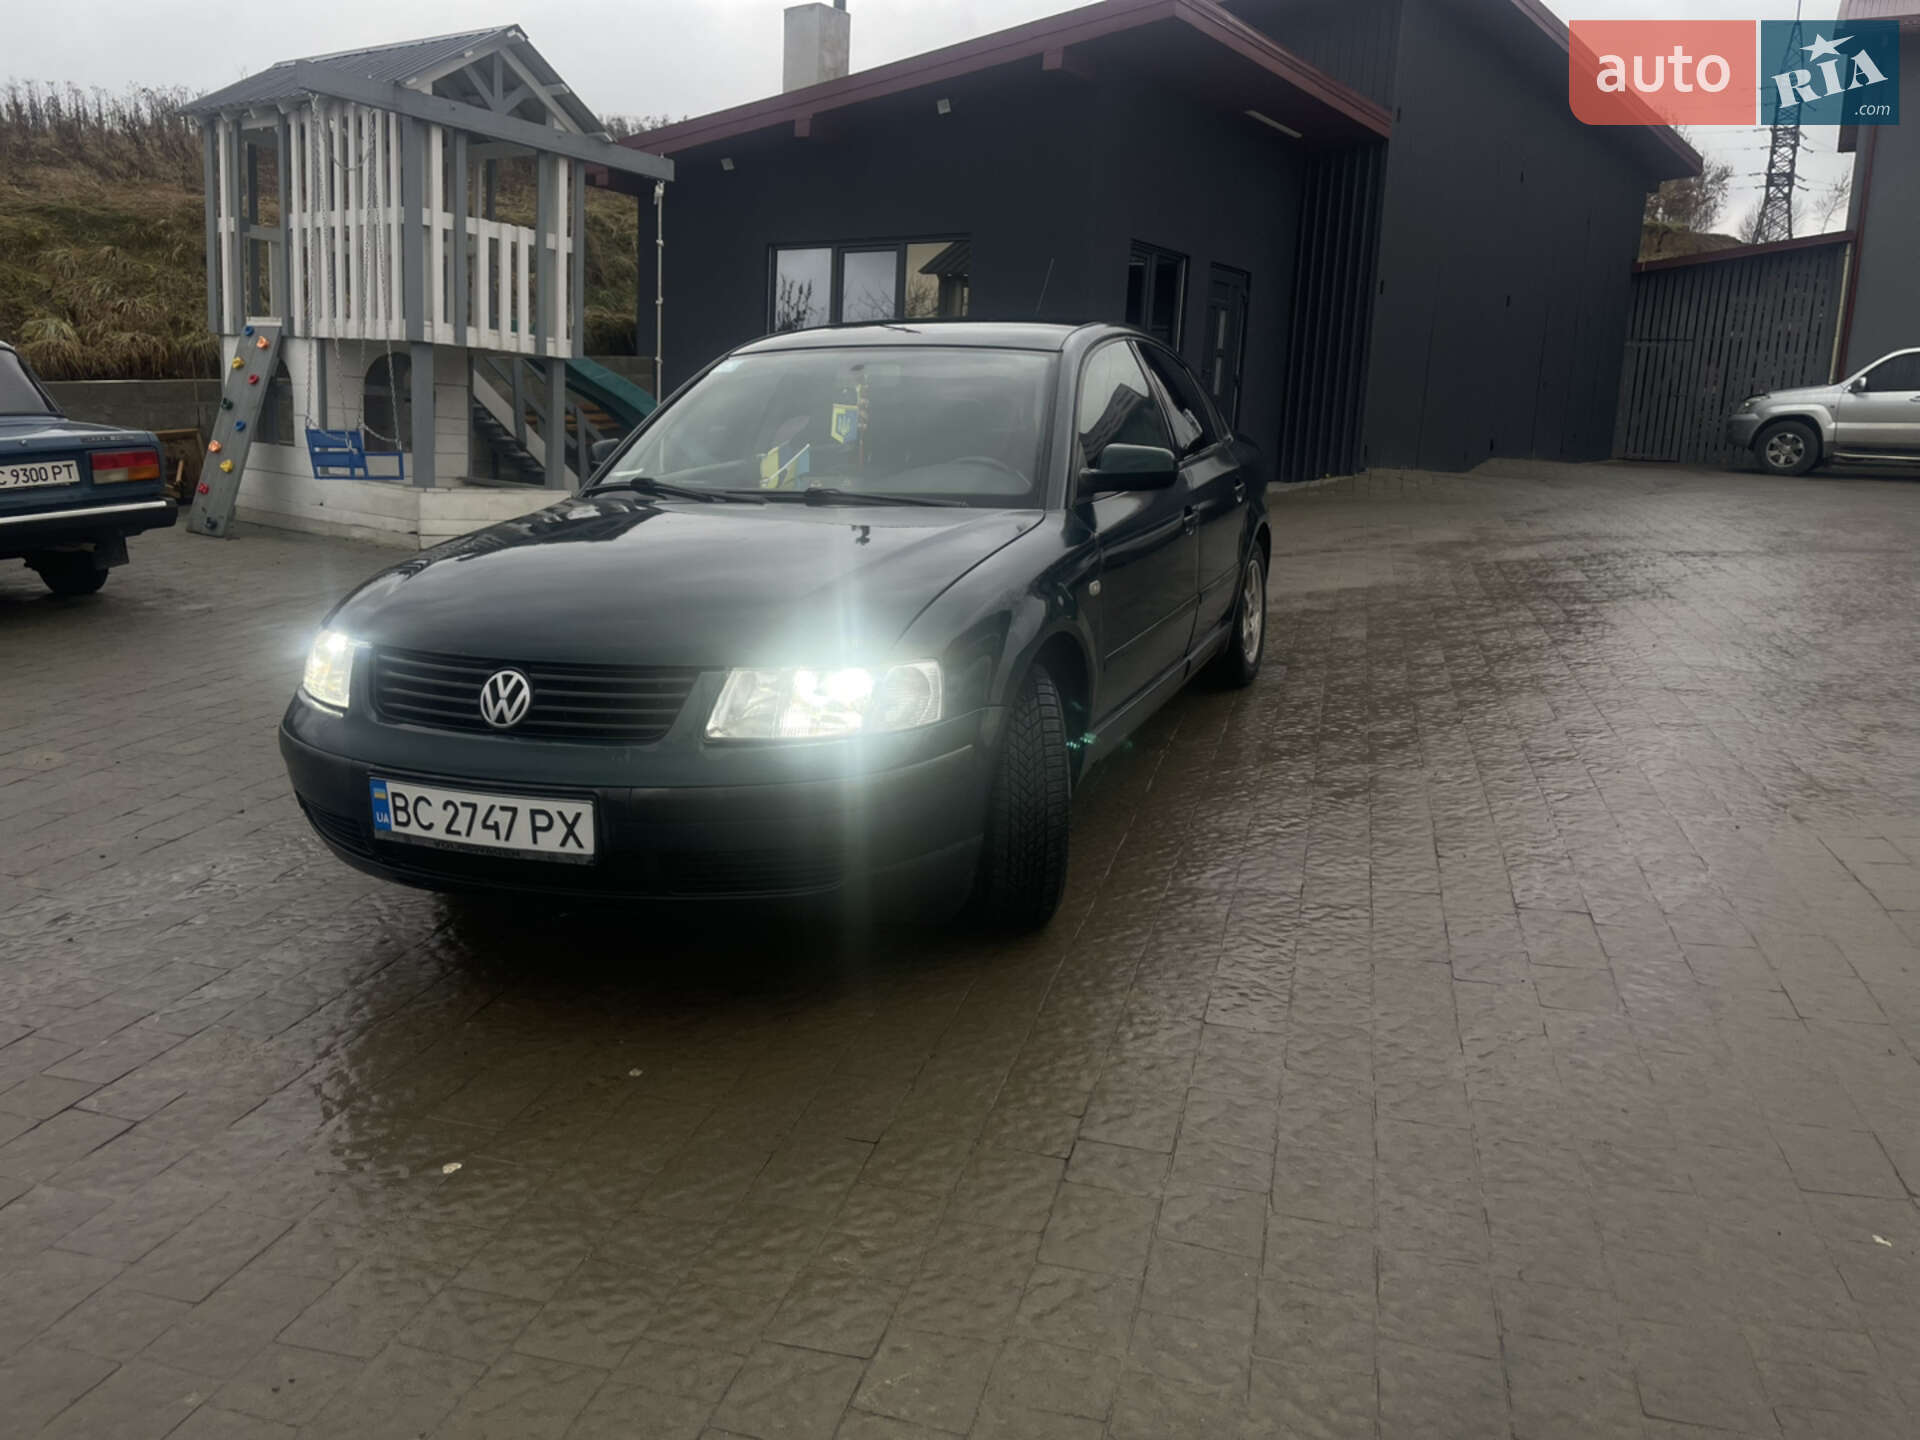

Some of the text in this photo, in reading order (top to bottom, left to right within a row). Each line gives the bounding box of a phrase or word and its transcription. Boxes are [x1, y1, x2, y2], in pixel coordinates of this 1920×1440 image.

[10, 466, 48, 485] 9300
[51, 464, 73, 481] PT
[376, 811, 390, 824] UA
[390, 792, 435, 831] BC
[442, 800, 519, 842] 2747
[529, 808, 585, 849] PX
